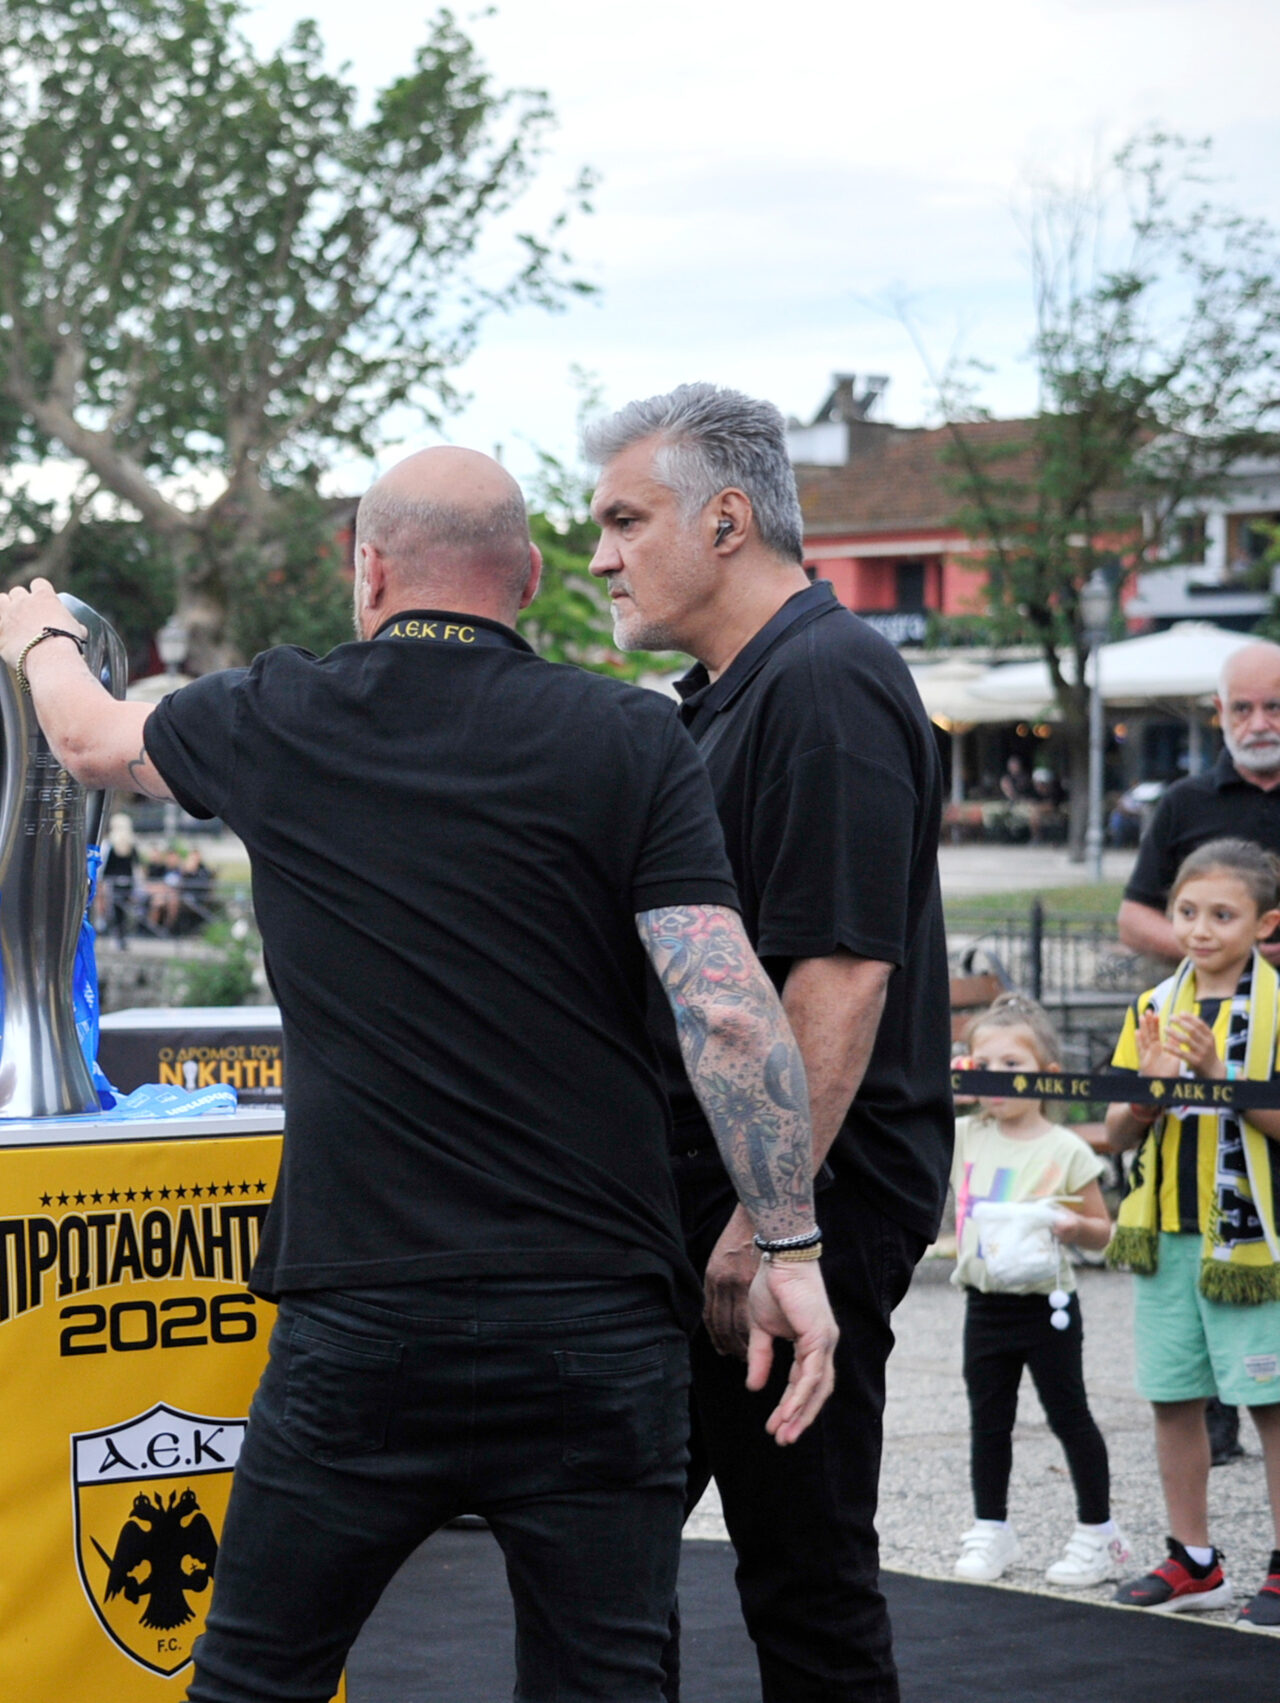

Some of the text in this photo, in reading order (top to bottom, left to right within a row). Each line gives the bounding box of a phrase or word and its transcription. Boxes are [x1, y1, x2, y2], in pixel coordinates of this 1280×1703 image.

[444, 625, 476, 643] FC
[177, 1045, 246, 1061] ΔΡΟΜΟΣ
[250, 1045, 280, 1060] ΤΟΥ
[1034, 1077, 1091, 1096] AEK FC
[1172, 1083, 1233, 1102] AEK FC
[59, 1293, 256, 1357] 2026
[157, 1638, 182, 1653] F.C.
